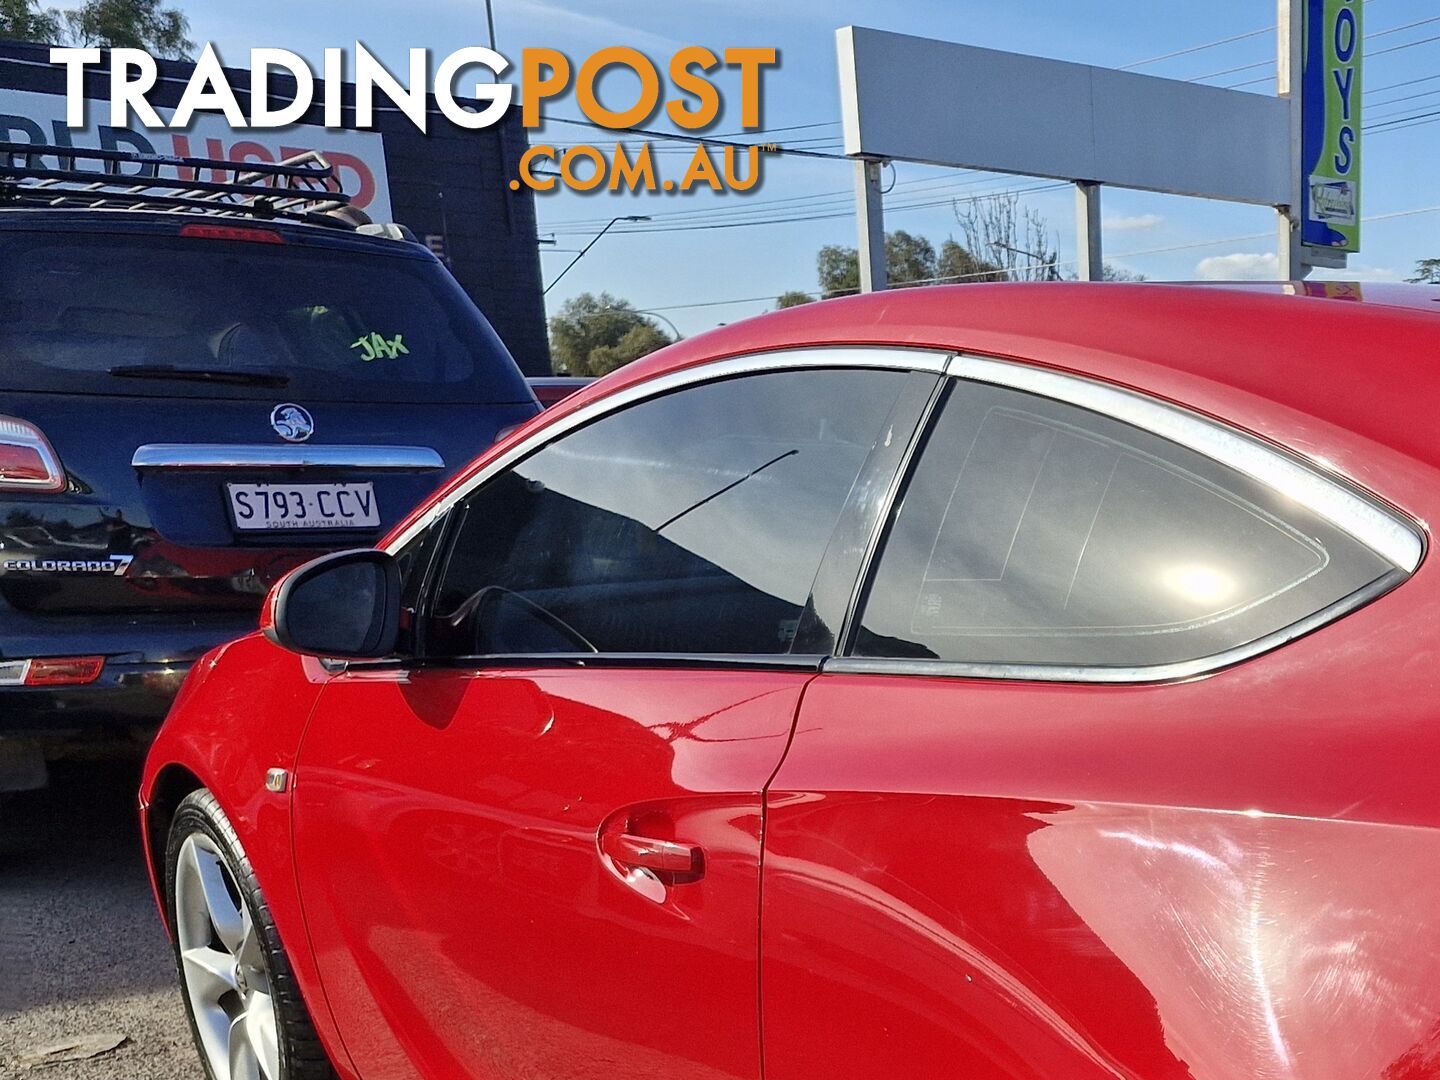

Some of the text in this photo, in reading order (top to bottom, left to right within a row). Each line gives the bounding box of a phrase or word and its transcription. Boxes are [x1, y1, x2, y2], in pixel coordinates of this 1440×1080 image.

[1333, 0, 1354, 174] OYS
[266, 519, 356, 529] SOUTH AUSTRALIA
